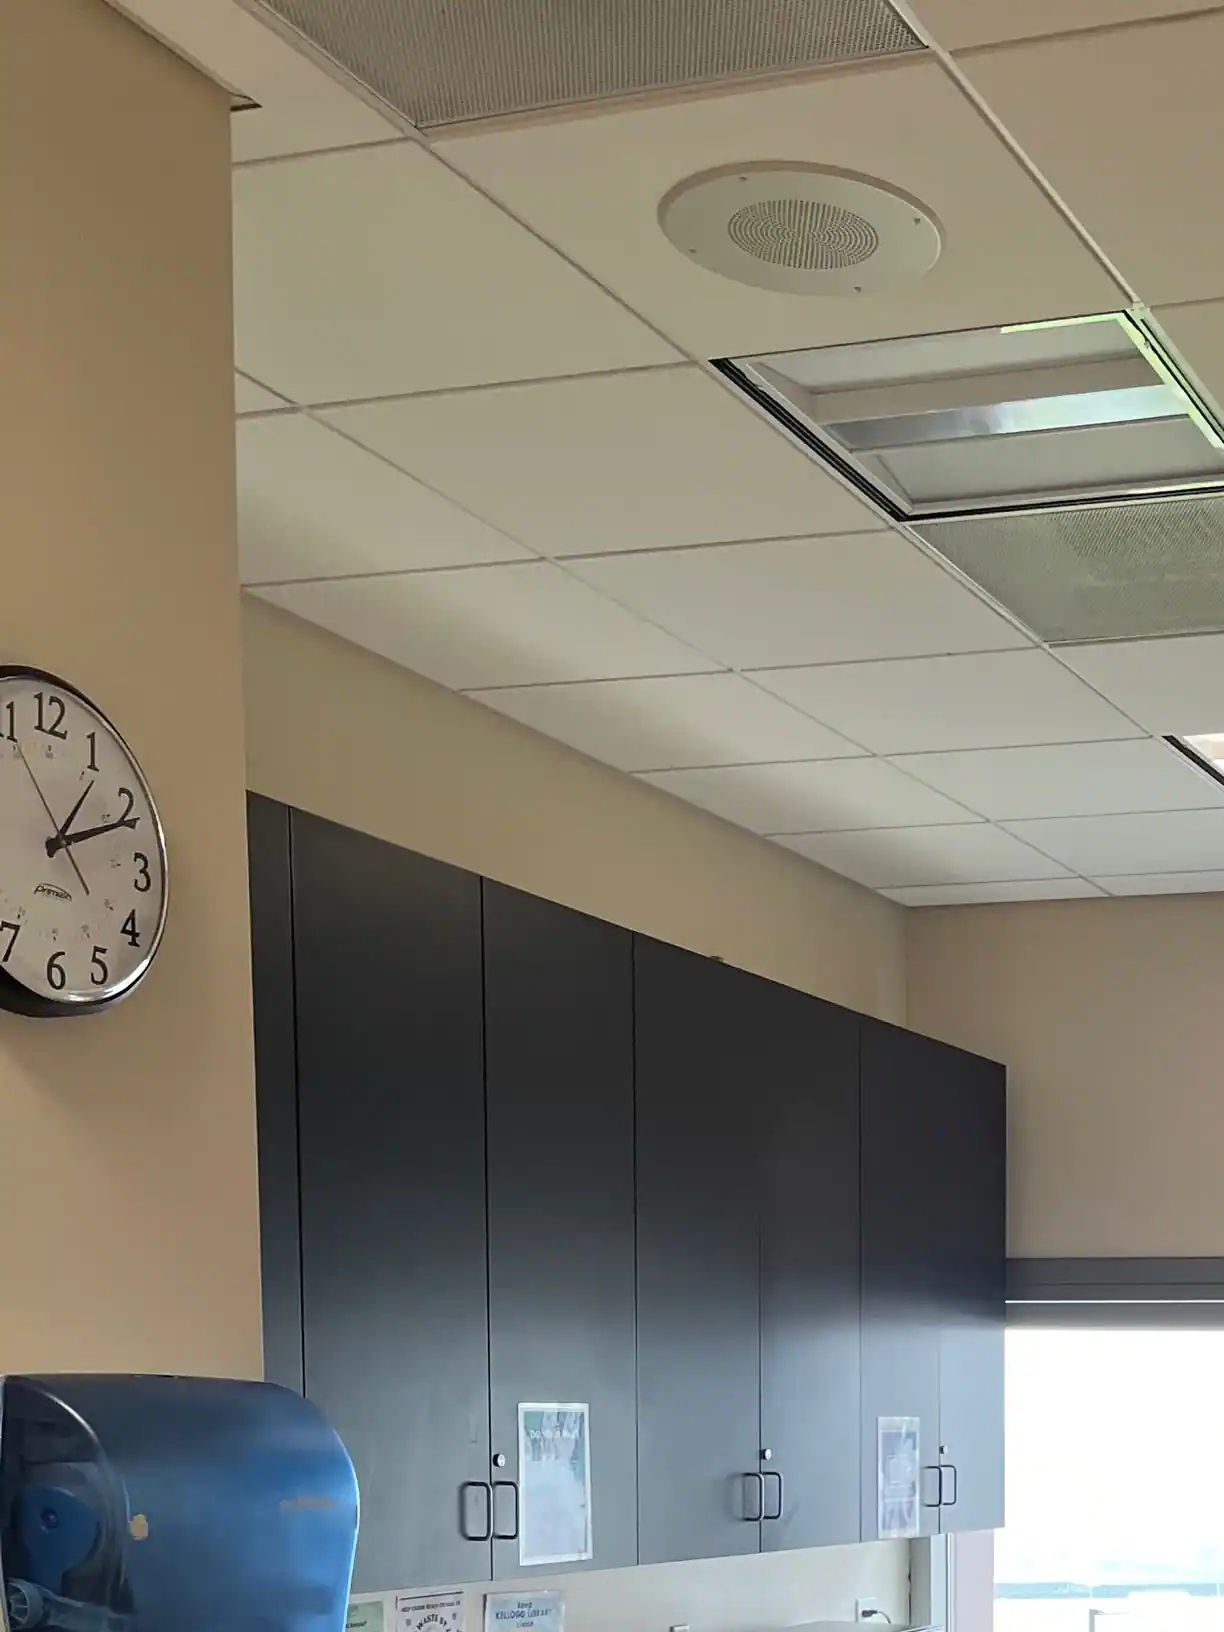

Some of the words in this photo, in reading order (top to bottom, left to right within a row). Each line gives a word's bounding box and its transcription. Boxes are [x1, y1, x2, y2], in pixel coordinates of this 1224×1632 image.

[0, 700, 18, 743] 1
[33, 692, 68, 740] 12
[86, 731, 100, 772] 1
[117, 787, 138, 830] 2
[133, 852, 151, 892] 3
[0, 920, 21, 962] 7
[120, 908, 141, 948] 4
[46, 950, 66, 990] 6
[90, 945, 108, 986] 5
